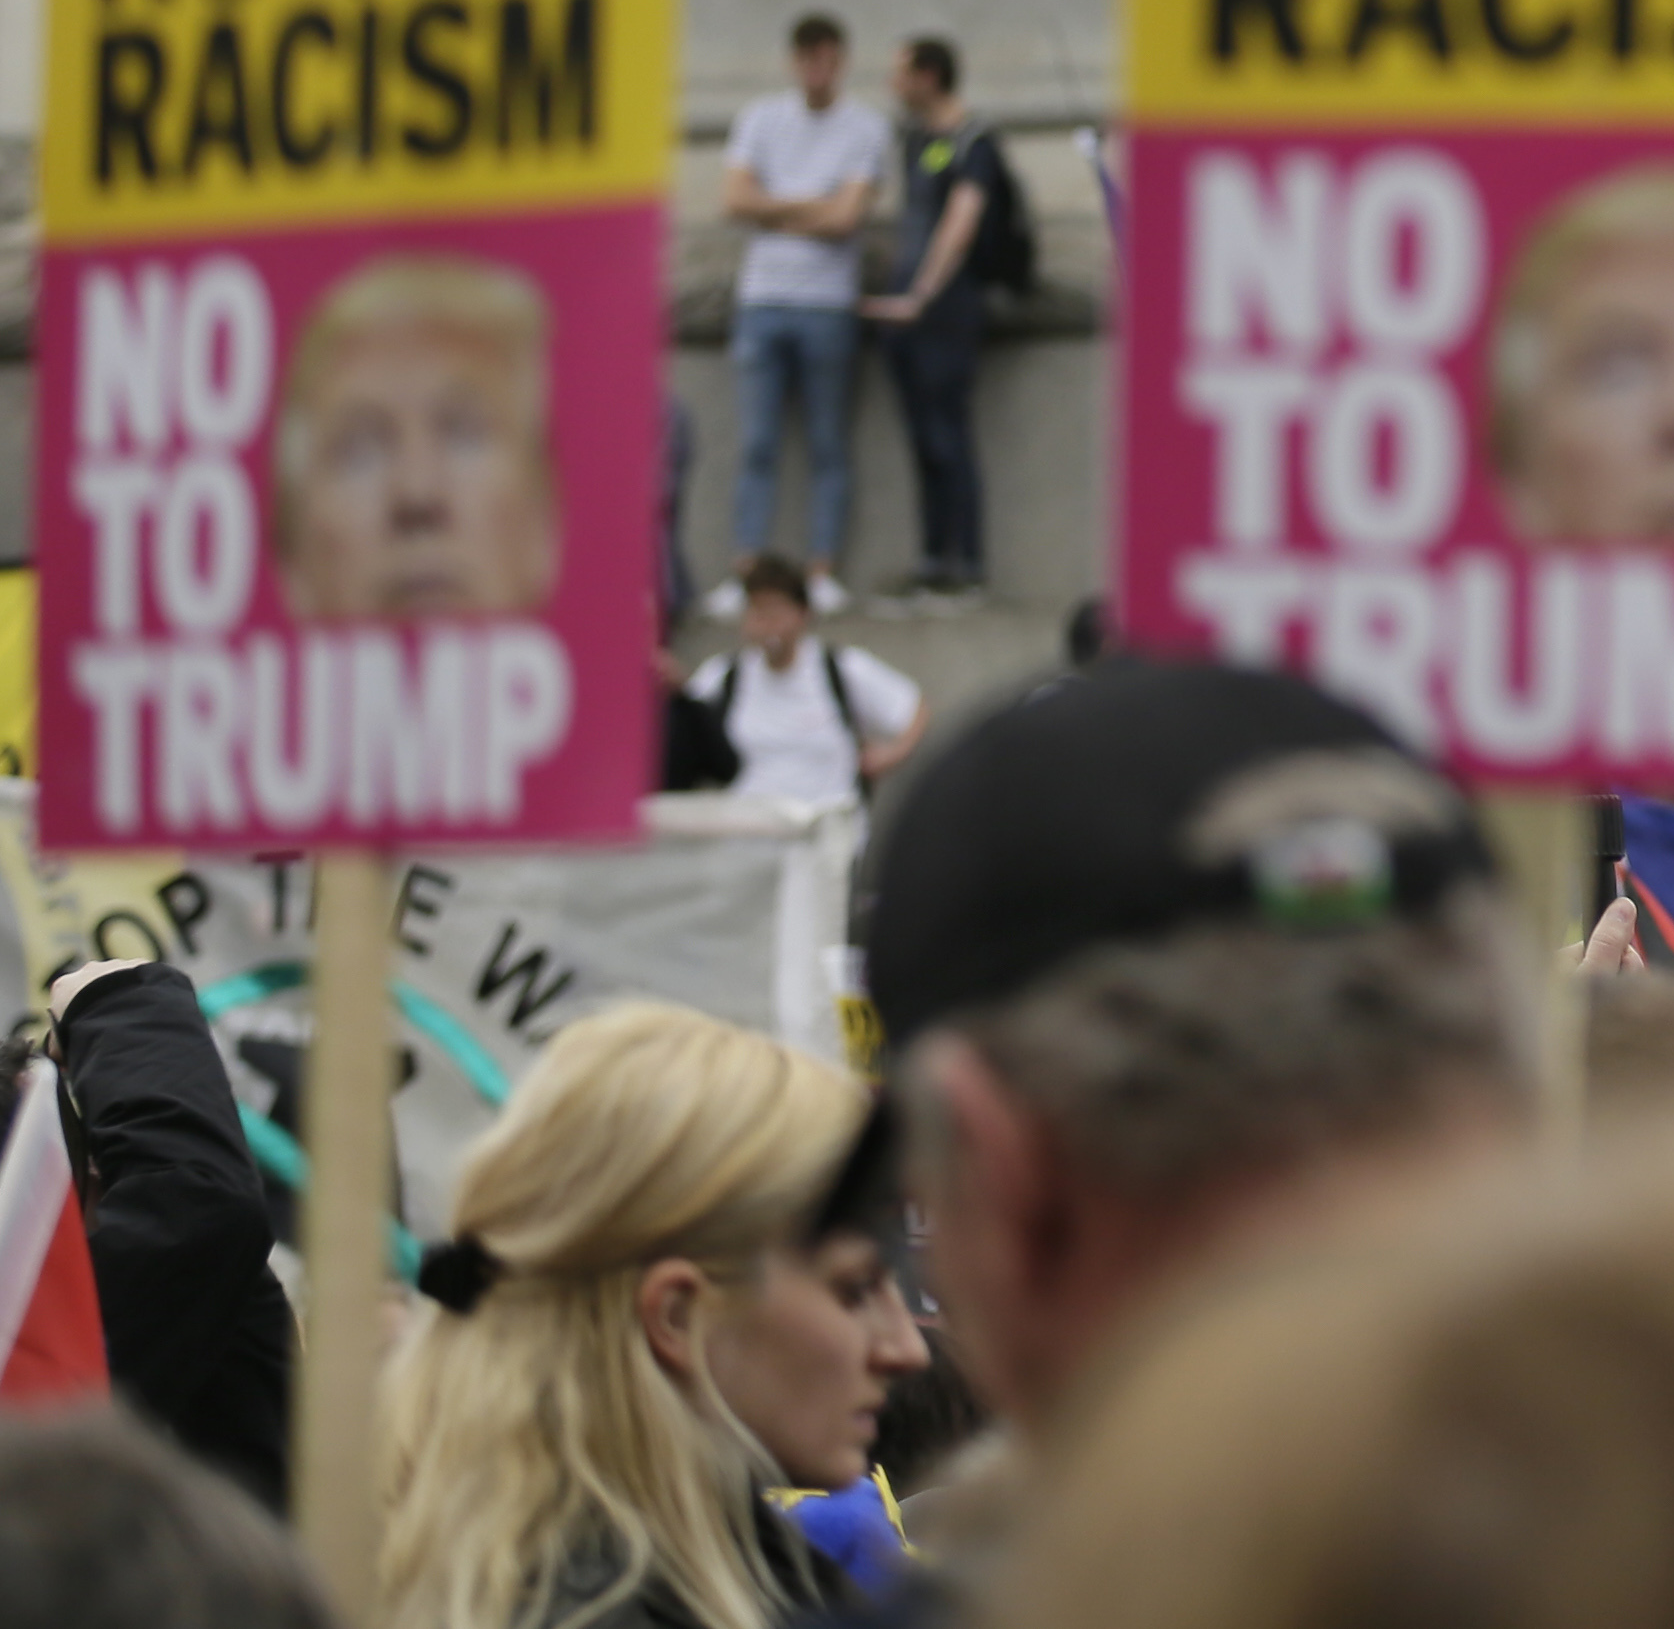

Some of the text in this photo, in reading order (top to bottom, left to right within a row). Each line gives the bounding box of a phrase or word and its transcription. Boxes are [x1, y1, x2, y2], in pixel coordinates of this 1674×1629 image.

[1185, 146, 1484, 353] NO
[78, 253, 274, 449] NO
[70, 456, 258, 639] TO
[1179, 363, 1465, 553] TO
[70, 621, 574, 835] TRUMP
